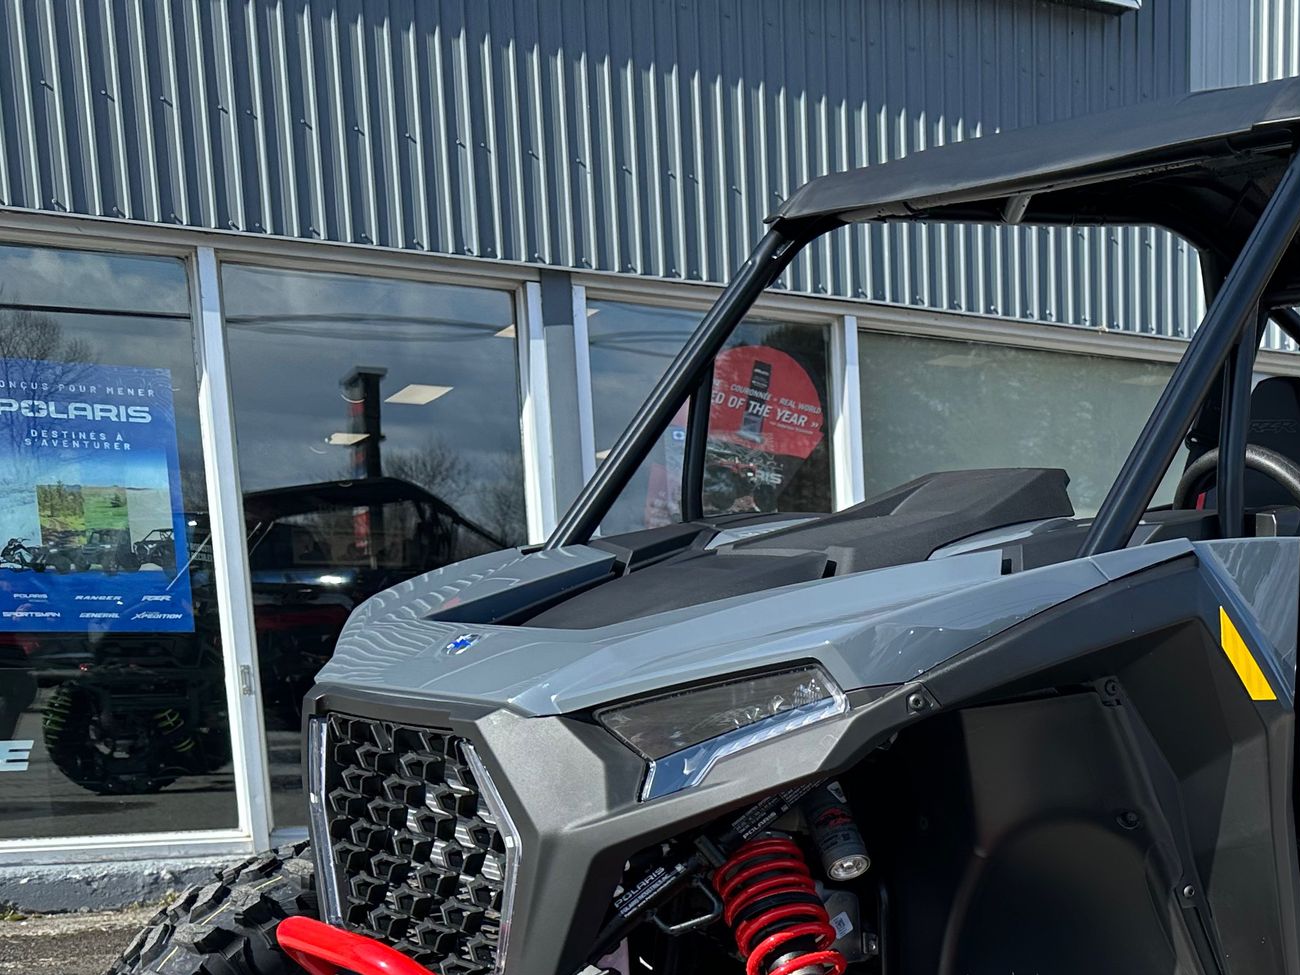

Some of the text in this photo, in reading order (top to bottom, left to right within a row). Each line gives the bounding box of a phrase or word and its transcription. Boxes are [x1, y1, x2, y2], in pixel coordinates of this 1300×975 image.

[58, 384, 97, 394] POUR
[106, 386, 155, 397] MENER
[0, 398, 152, 423] POLARIS
[727, 395, 746, 409] OF
[748, 400, 773, 417] THE
[775, 408, 808, 427] YEAR
[24, 438, 131, 450] S'AVENTURER
[31, 429, 107, 441] DESTINÉS
[613, 866, 665, 909] POLARIS
